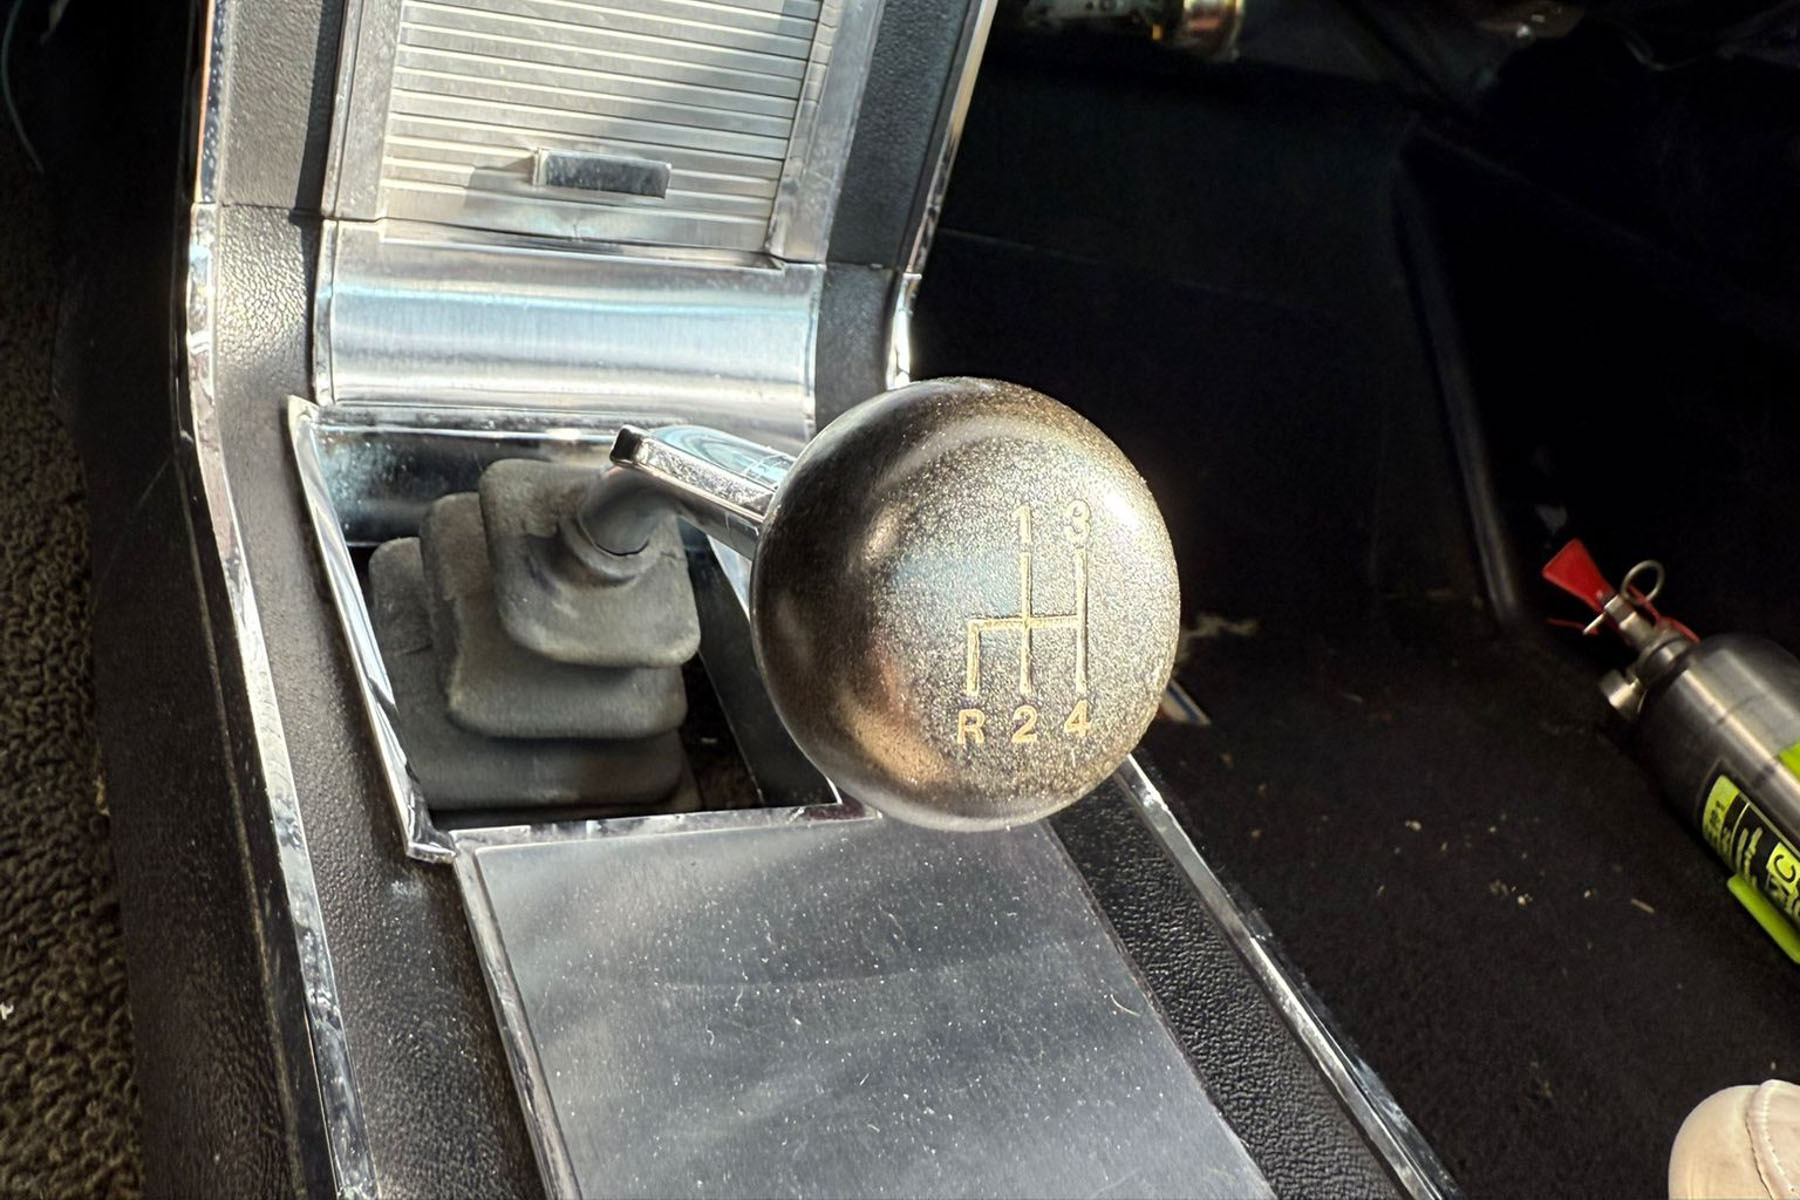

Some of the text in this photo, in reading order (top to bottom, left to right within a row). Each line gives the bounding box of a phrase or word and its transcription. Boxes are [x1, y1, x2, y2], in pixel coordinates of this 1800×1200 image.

[1012, 500, 1091, 544] 1 3
[957, 701, 1091, 745] R 2 4
